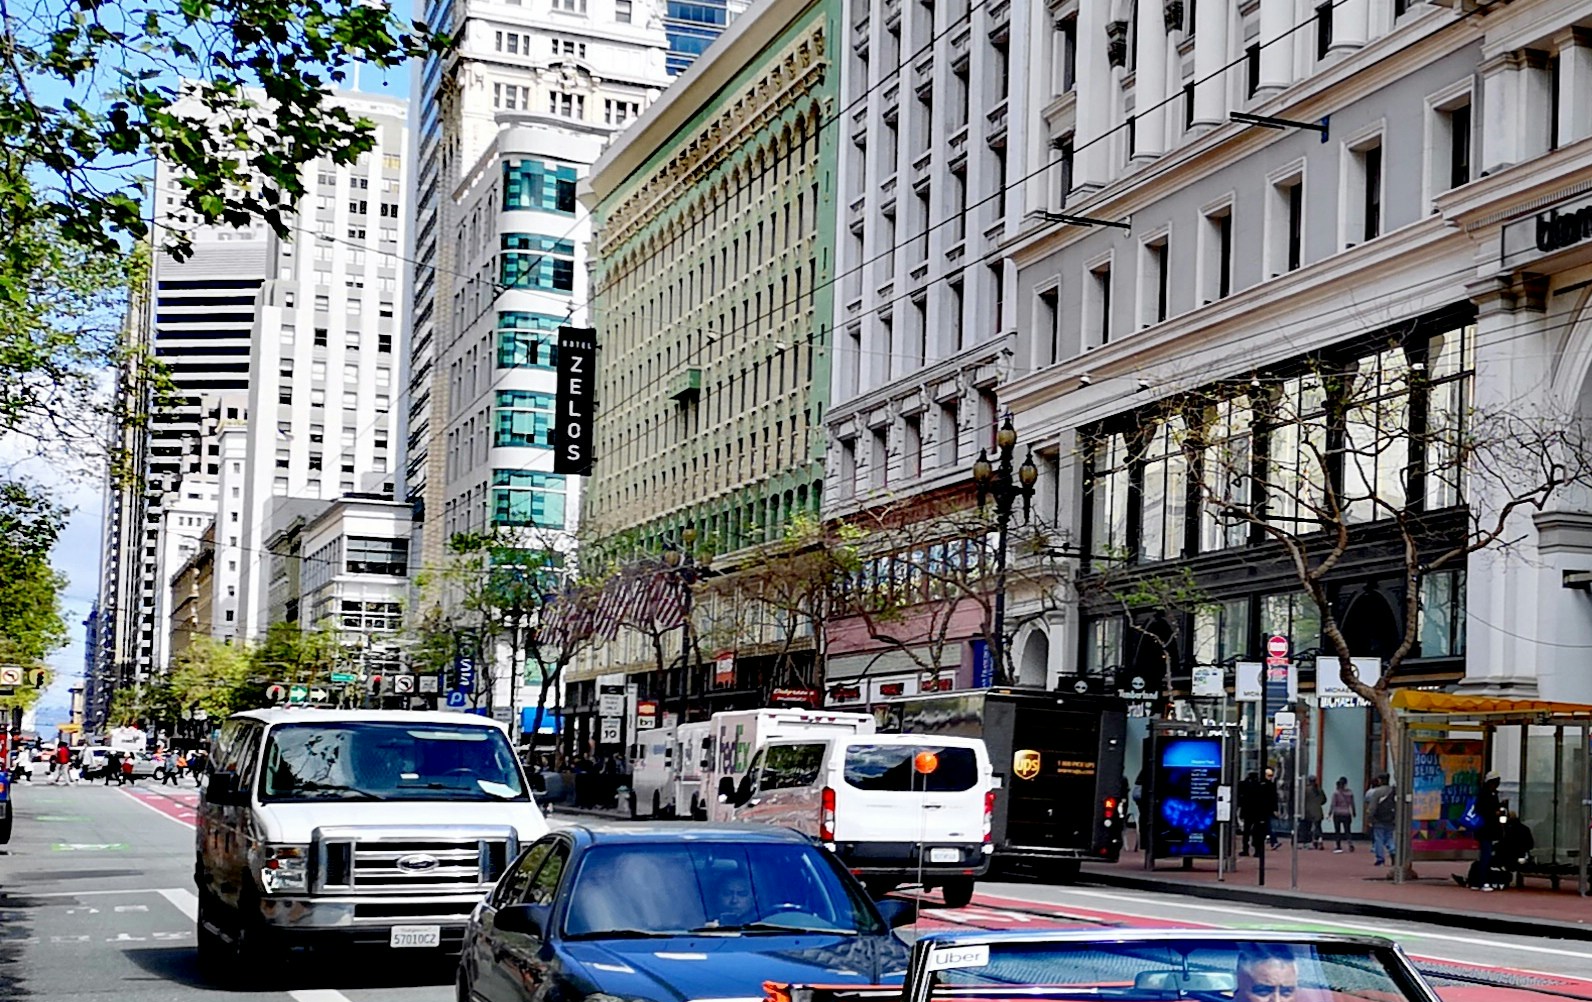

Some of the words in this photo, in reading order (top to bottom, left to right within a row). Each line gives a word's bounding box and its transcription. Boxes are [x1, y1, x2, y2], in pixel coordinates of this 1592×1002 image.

[566, 355, 583, 461] ZELOS
[1117, 688, 1159, 700] Timberland
[1015, 757, 1039, 776] ups
[935, 952, 981, 965] Uber
